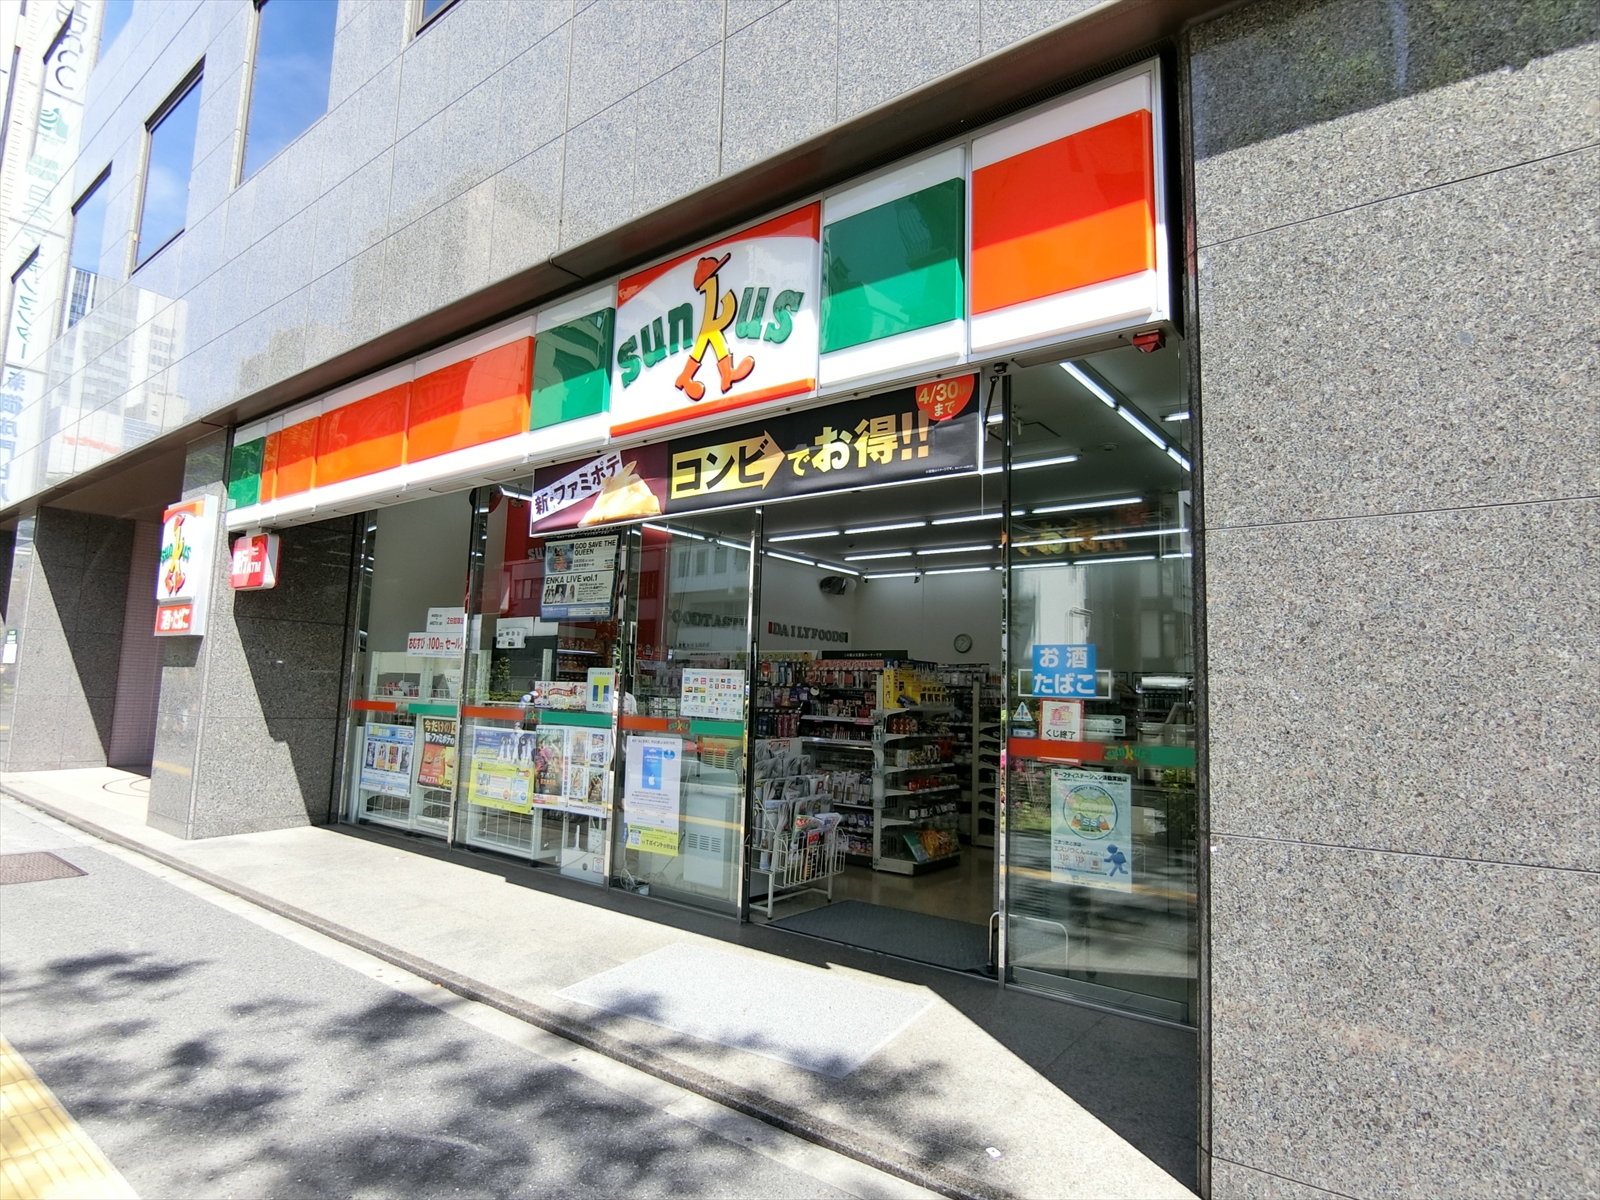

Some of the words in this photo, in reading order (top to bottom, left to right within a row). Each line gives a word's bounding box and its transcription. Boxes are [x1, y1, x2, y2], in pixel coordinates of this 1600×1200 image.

[934, 400, 956, 417] まで
[535, 454, 620, 516] 新・ファミポテ
[575, 542, 587, 550] GOD
[588, 540, 602, 549] SAVE
[604, 539, 616, 547] THE
[574, 548, 594, 556] QUEEN
[545, 576, 564, 585] ENKA
[566, 575, 582, 584] LIVE
[583, 573, 598, 582] vol.1
[1039, 646, 1088, 669] お酒
[1034, 672, 1095, 694] たばこ
[1046, 729, 1076, 740] くじ終了
[1083, 818, 1098, 826] SS
